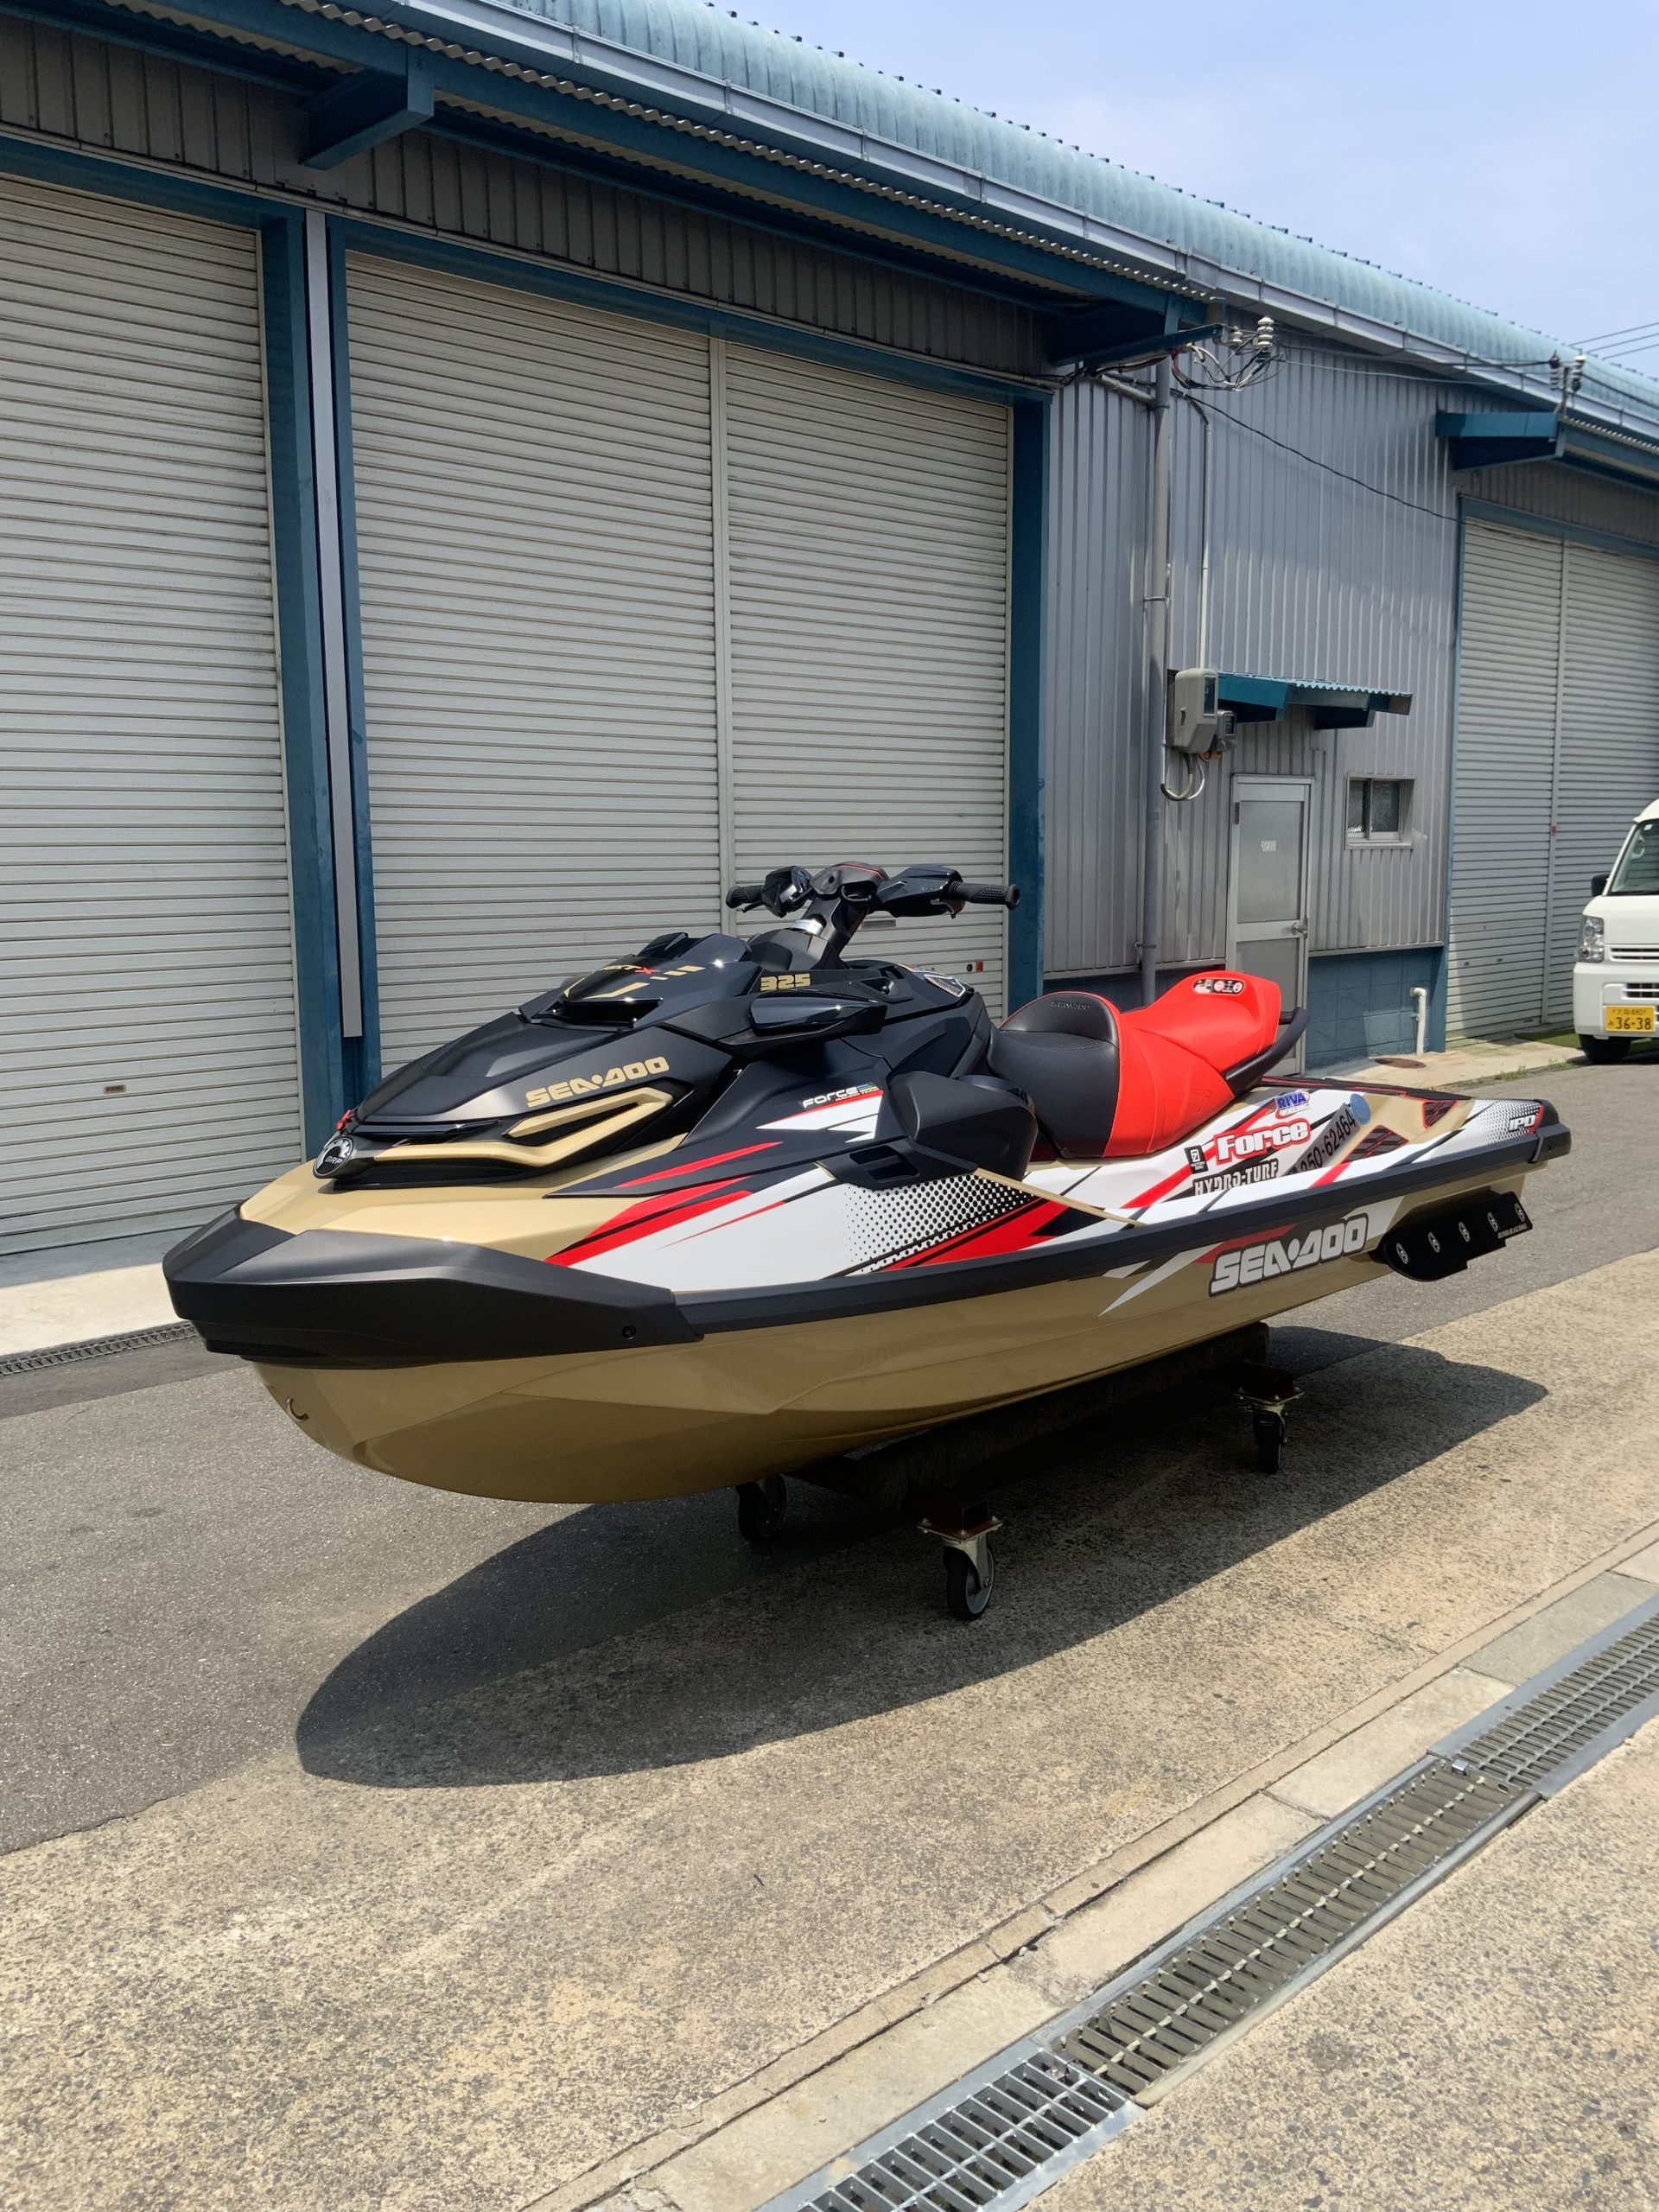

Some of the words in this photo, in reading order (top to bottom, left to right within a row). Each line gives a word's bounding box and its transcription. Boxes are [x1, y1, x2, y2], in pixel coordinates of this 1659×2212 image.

[760, 973, 811, 992] 325
[1616, 1017, 1651, 1030] 36-38
[1277, 1091, 1306, 1109] RIVA
[1217, 1121, 1309, 1161] Force
[325, 1156, 344, 1165] BRP
